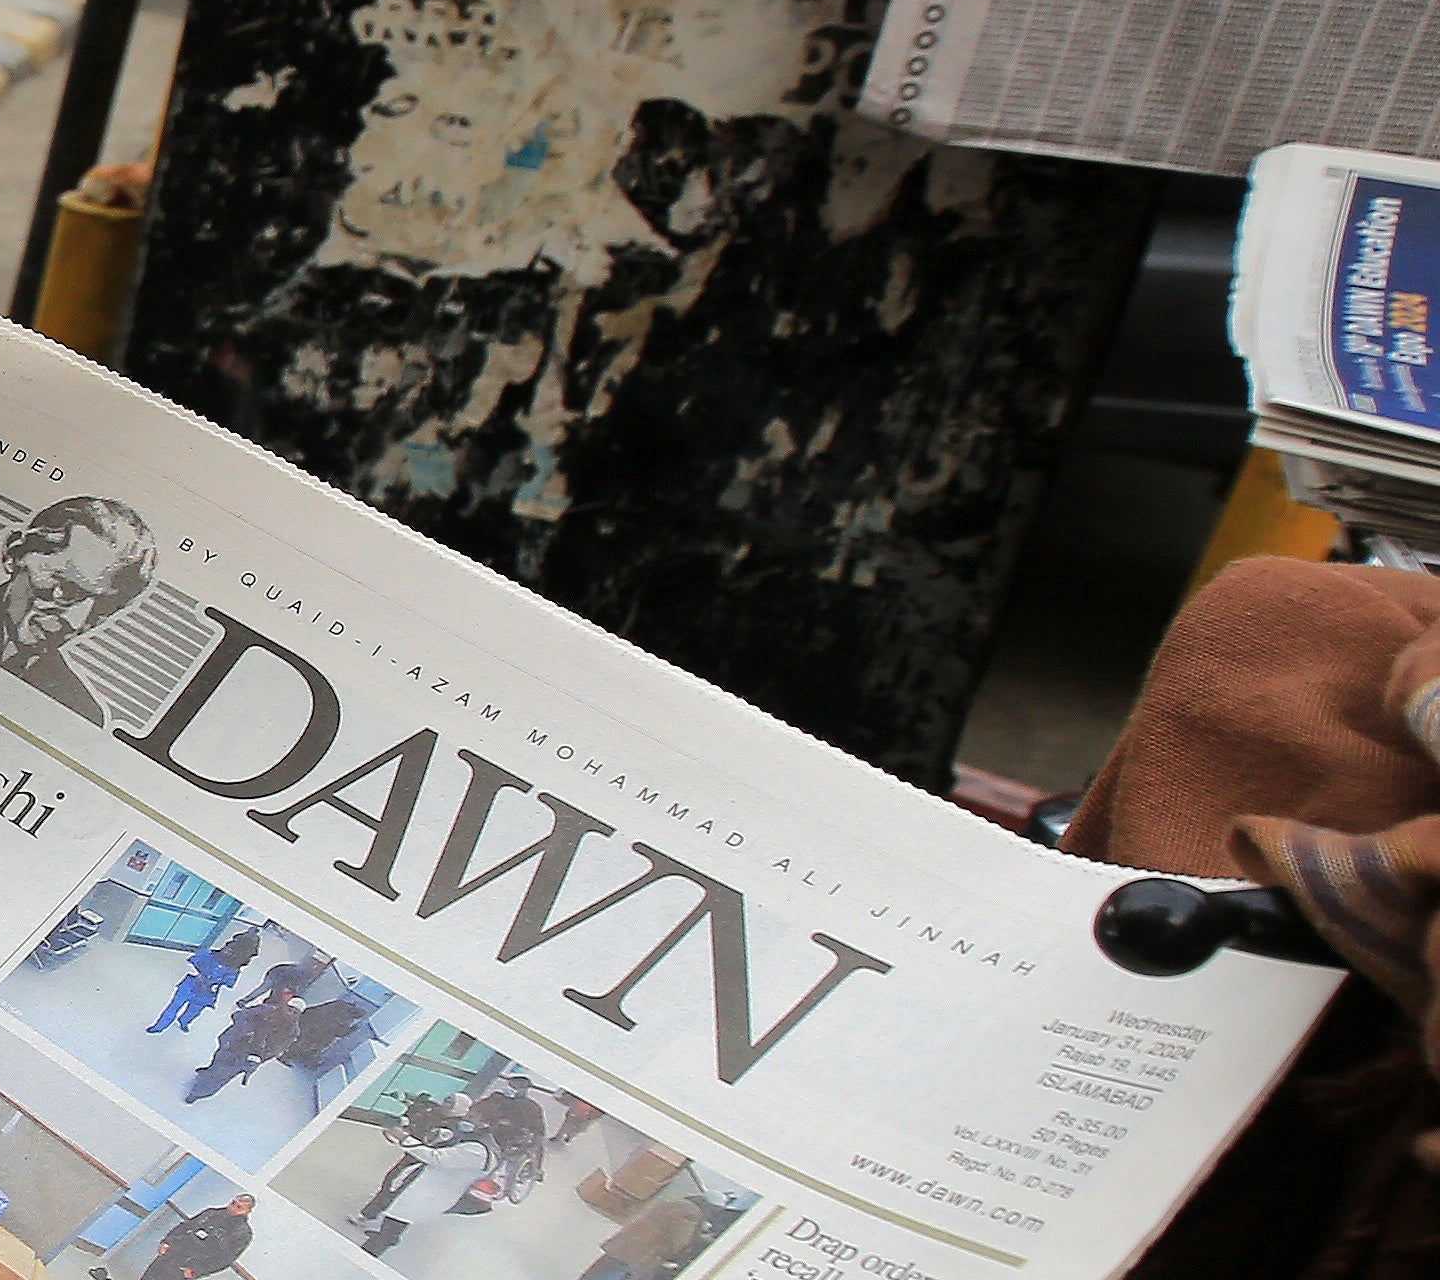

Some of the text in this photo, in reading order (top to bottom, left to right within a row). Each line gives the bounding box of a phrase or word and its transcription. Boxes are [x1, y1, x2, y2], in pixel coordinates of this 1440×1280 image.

[1347, 195, 1402, 290] Education
[177, 536, 218, 564] BY
[239, 571, 502, 722] QUAID-I-AZAM
[525, 728, 744, 847] MOHAMMAD
[771, 857, 842, 895] ALI
[869, 905, 1037, 976] JINNAH
[110, 604, 895, 1086] DAWN
[1105, 1009, 1212, 1043] Wednesday
[1035, 1071, 1154, 1111] ISLAMABAD
[849, 1153, 1045, 1232] www.dawn.com
[783, 1215, 860, 1263] Drap
